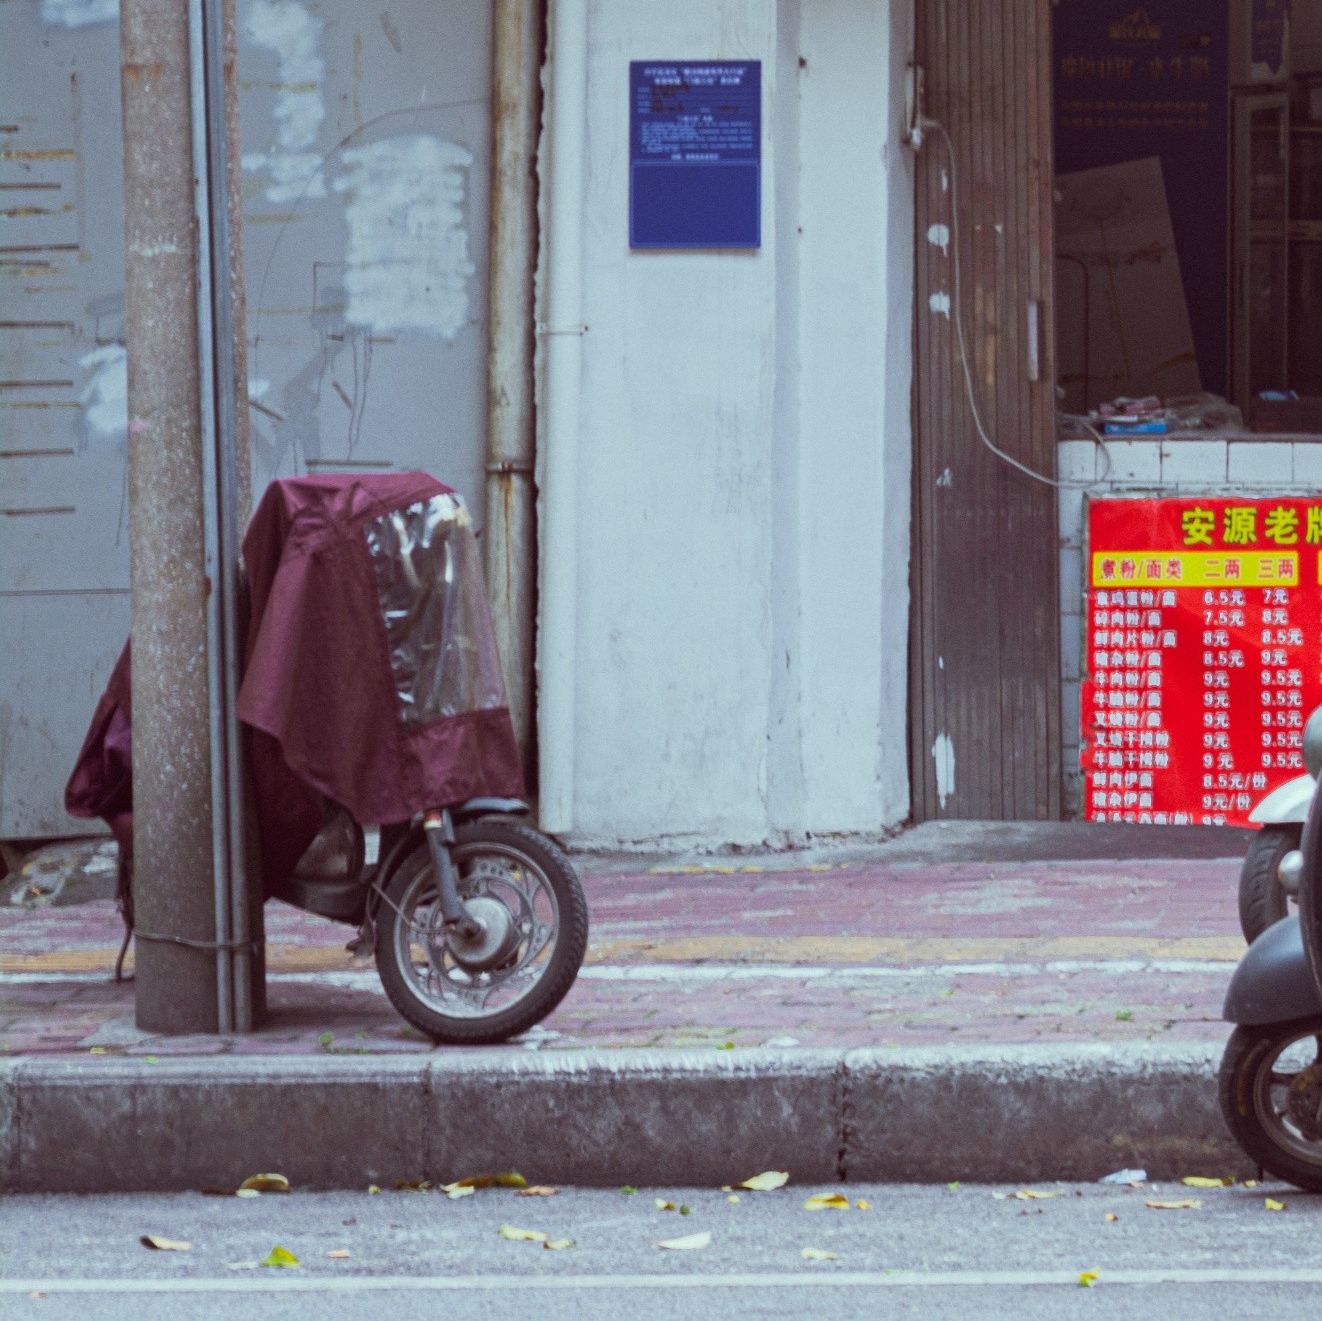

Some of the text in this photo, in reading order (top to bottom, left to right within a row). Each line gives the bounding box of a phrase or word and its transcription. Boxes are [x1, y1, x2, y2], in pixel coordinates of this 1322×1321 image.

[1204, 558, 1241, 580] 二两
[1257, 558, 1295, 580] 三两
[1203, 590, 1245, 607] 6.5元
[1262, 589, 1289, 605] 7元
[1203, 610, 1245, 627] 7.5元
[1261, 609, 1289, 626] 8元
[1203, 630, 1229, 647] 8元
[1261, 629, 1304, 646] 8.5元
[1203, 650, 1244, 668] 8.5元
[1260, 649, 1288, 665] 9元
[1203, 671, 1230, 688] 9元
[1261, 669, 1303, 687] 9.5元
[1203, 691, 1230, 708] 9元
[1261, 690, 1303, 707] 9.5元
[1203, 711, 1230, 729] 9元
[1261, 710, 1303, 727] 9.5元
[1203, 731, 1230, 749] 9元
[1261, 731, 1303, 748] 9.5元
[1261, 751, 1303, 768] 9.5元
[1203, 773, 1267, 790] 8.5元/份
[1202, 793, 1251, 810] 9元/份
